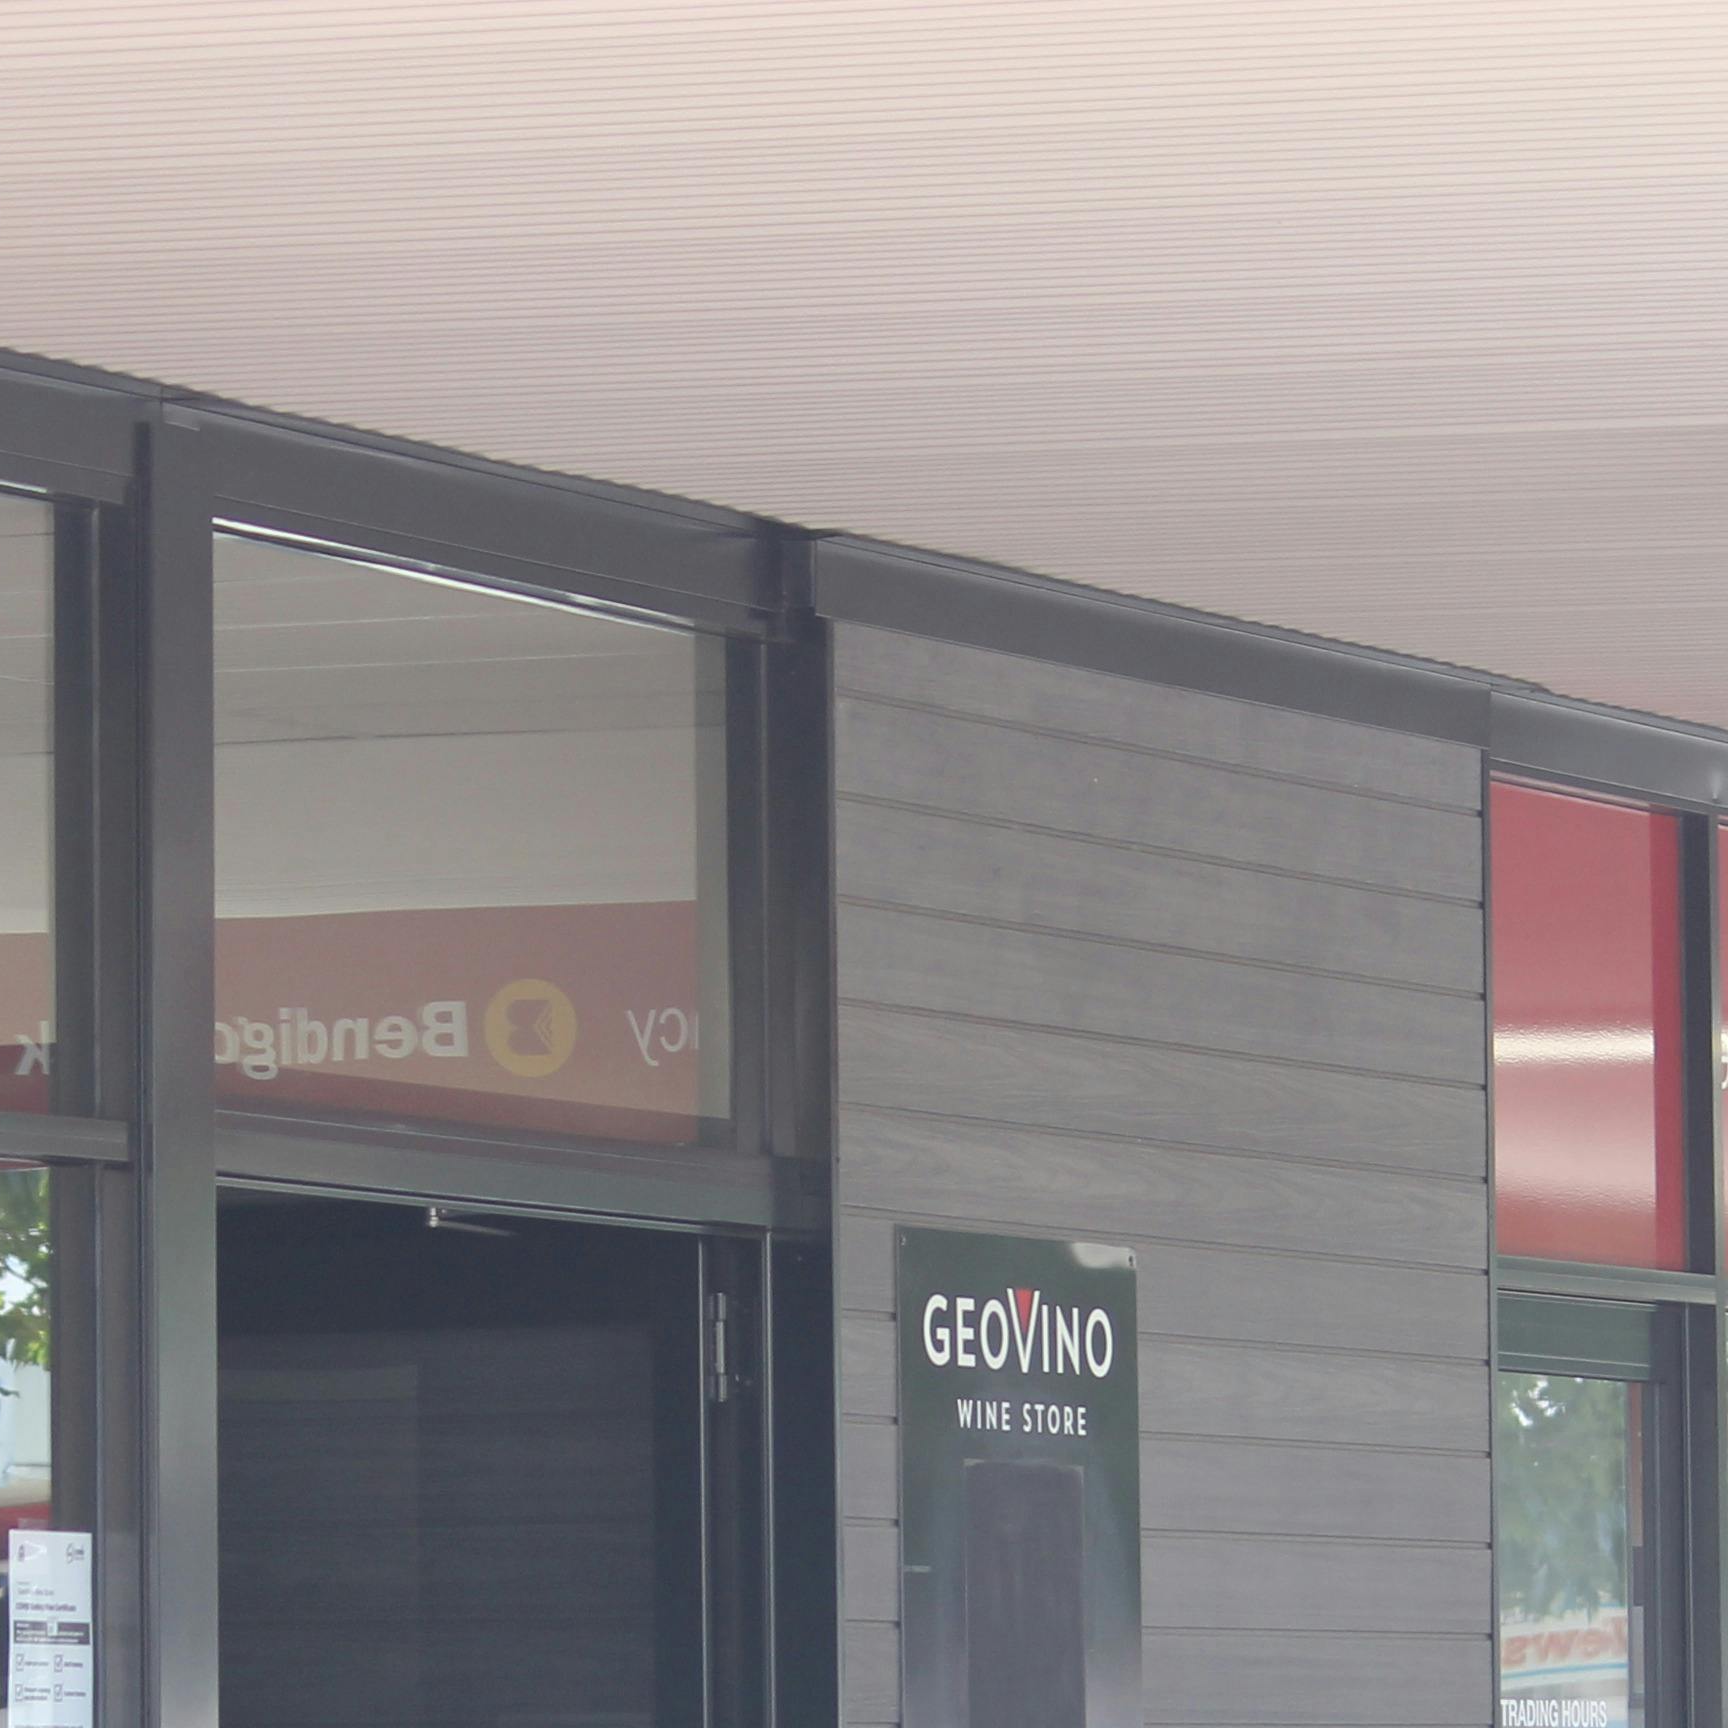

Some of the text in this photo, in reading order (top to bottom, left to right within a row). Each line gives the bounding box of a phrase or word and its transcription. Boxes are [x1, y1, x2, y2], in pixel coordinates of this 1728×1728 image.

[923, 1287, 1114, 1379] GEOVINO
[957, 1397, 1088, 1436] WINE STORE
[1500, 1699, 1608, 1728] TRADING HOURS
